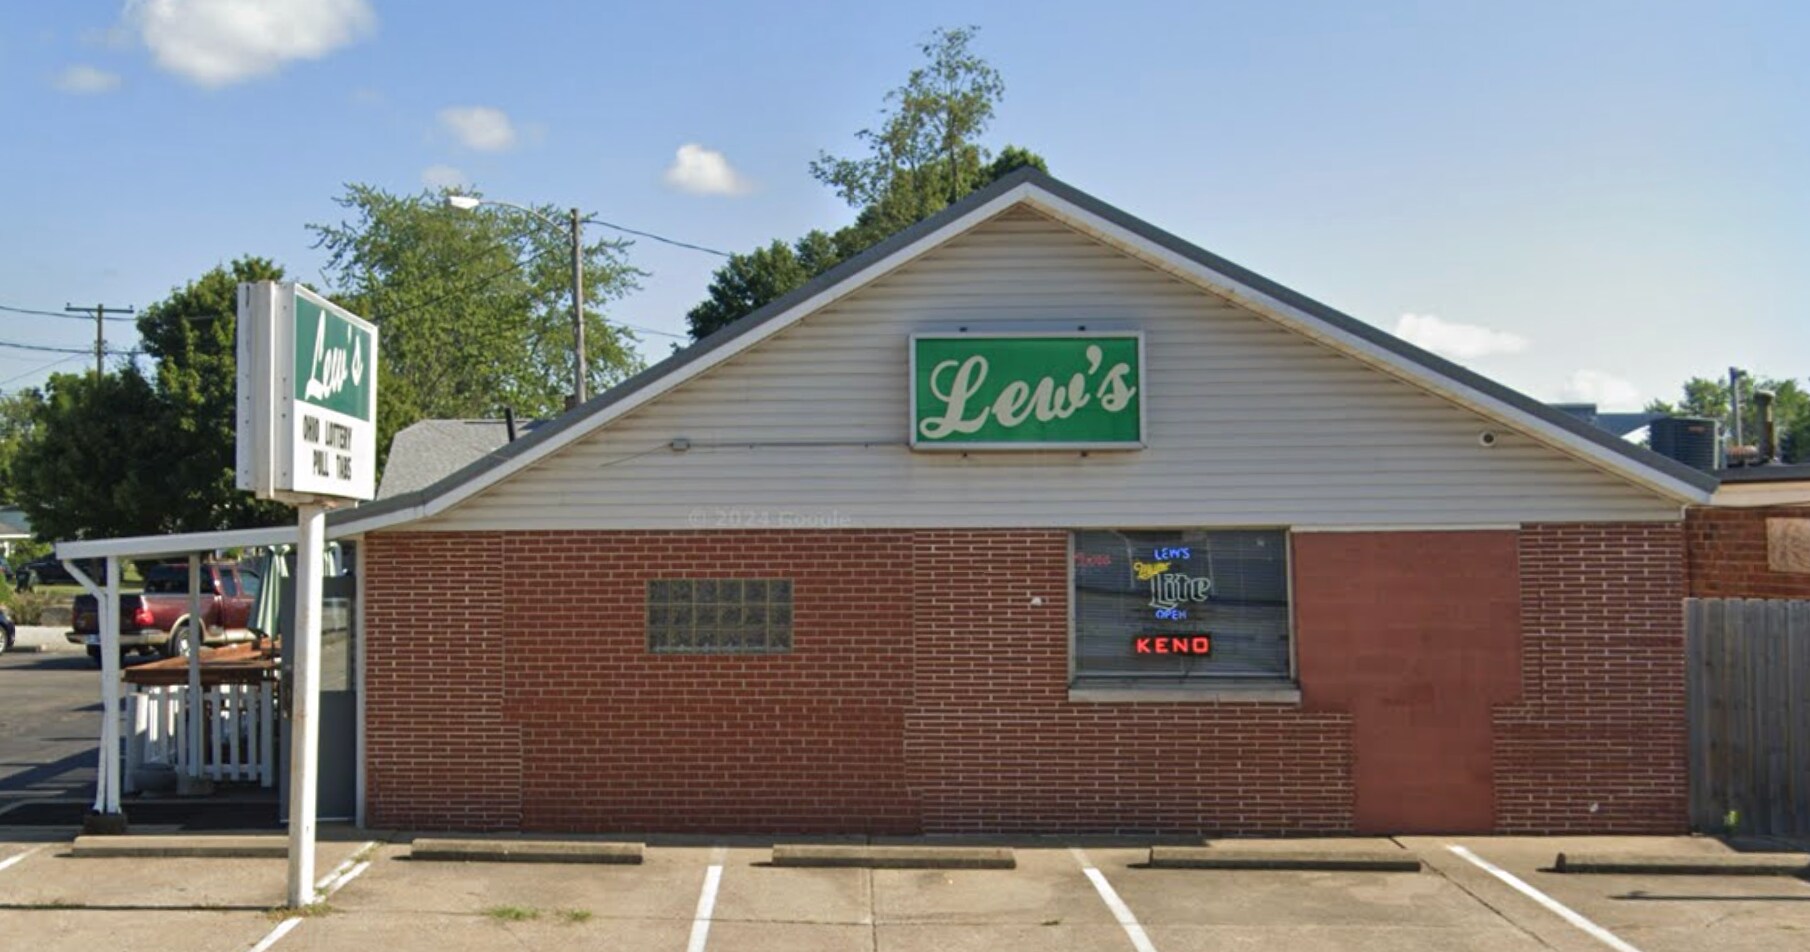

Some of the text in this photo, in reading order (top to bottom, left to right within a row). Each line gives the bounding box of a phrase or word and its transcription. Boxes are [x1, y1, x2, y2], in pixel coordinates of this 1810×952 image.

[304, 309, 363, 400] Lew's
[919, 344, 1137, 439] Lew's
[325, 420, 353, 451] LOTTERY
[313, 449, 352, 481] PULL TABS
[1148, 573, 1211, 610] Lite
[1155, 610, 1187, 621] OPEN
[1136, 636, 1209, 654] KENO
